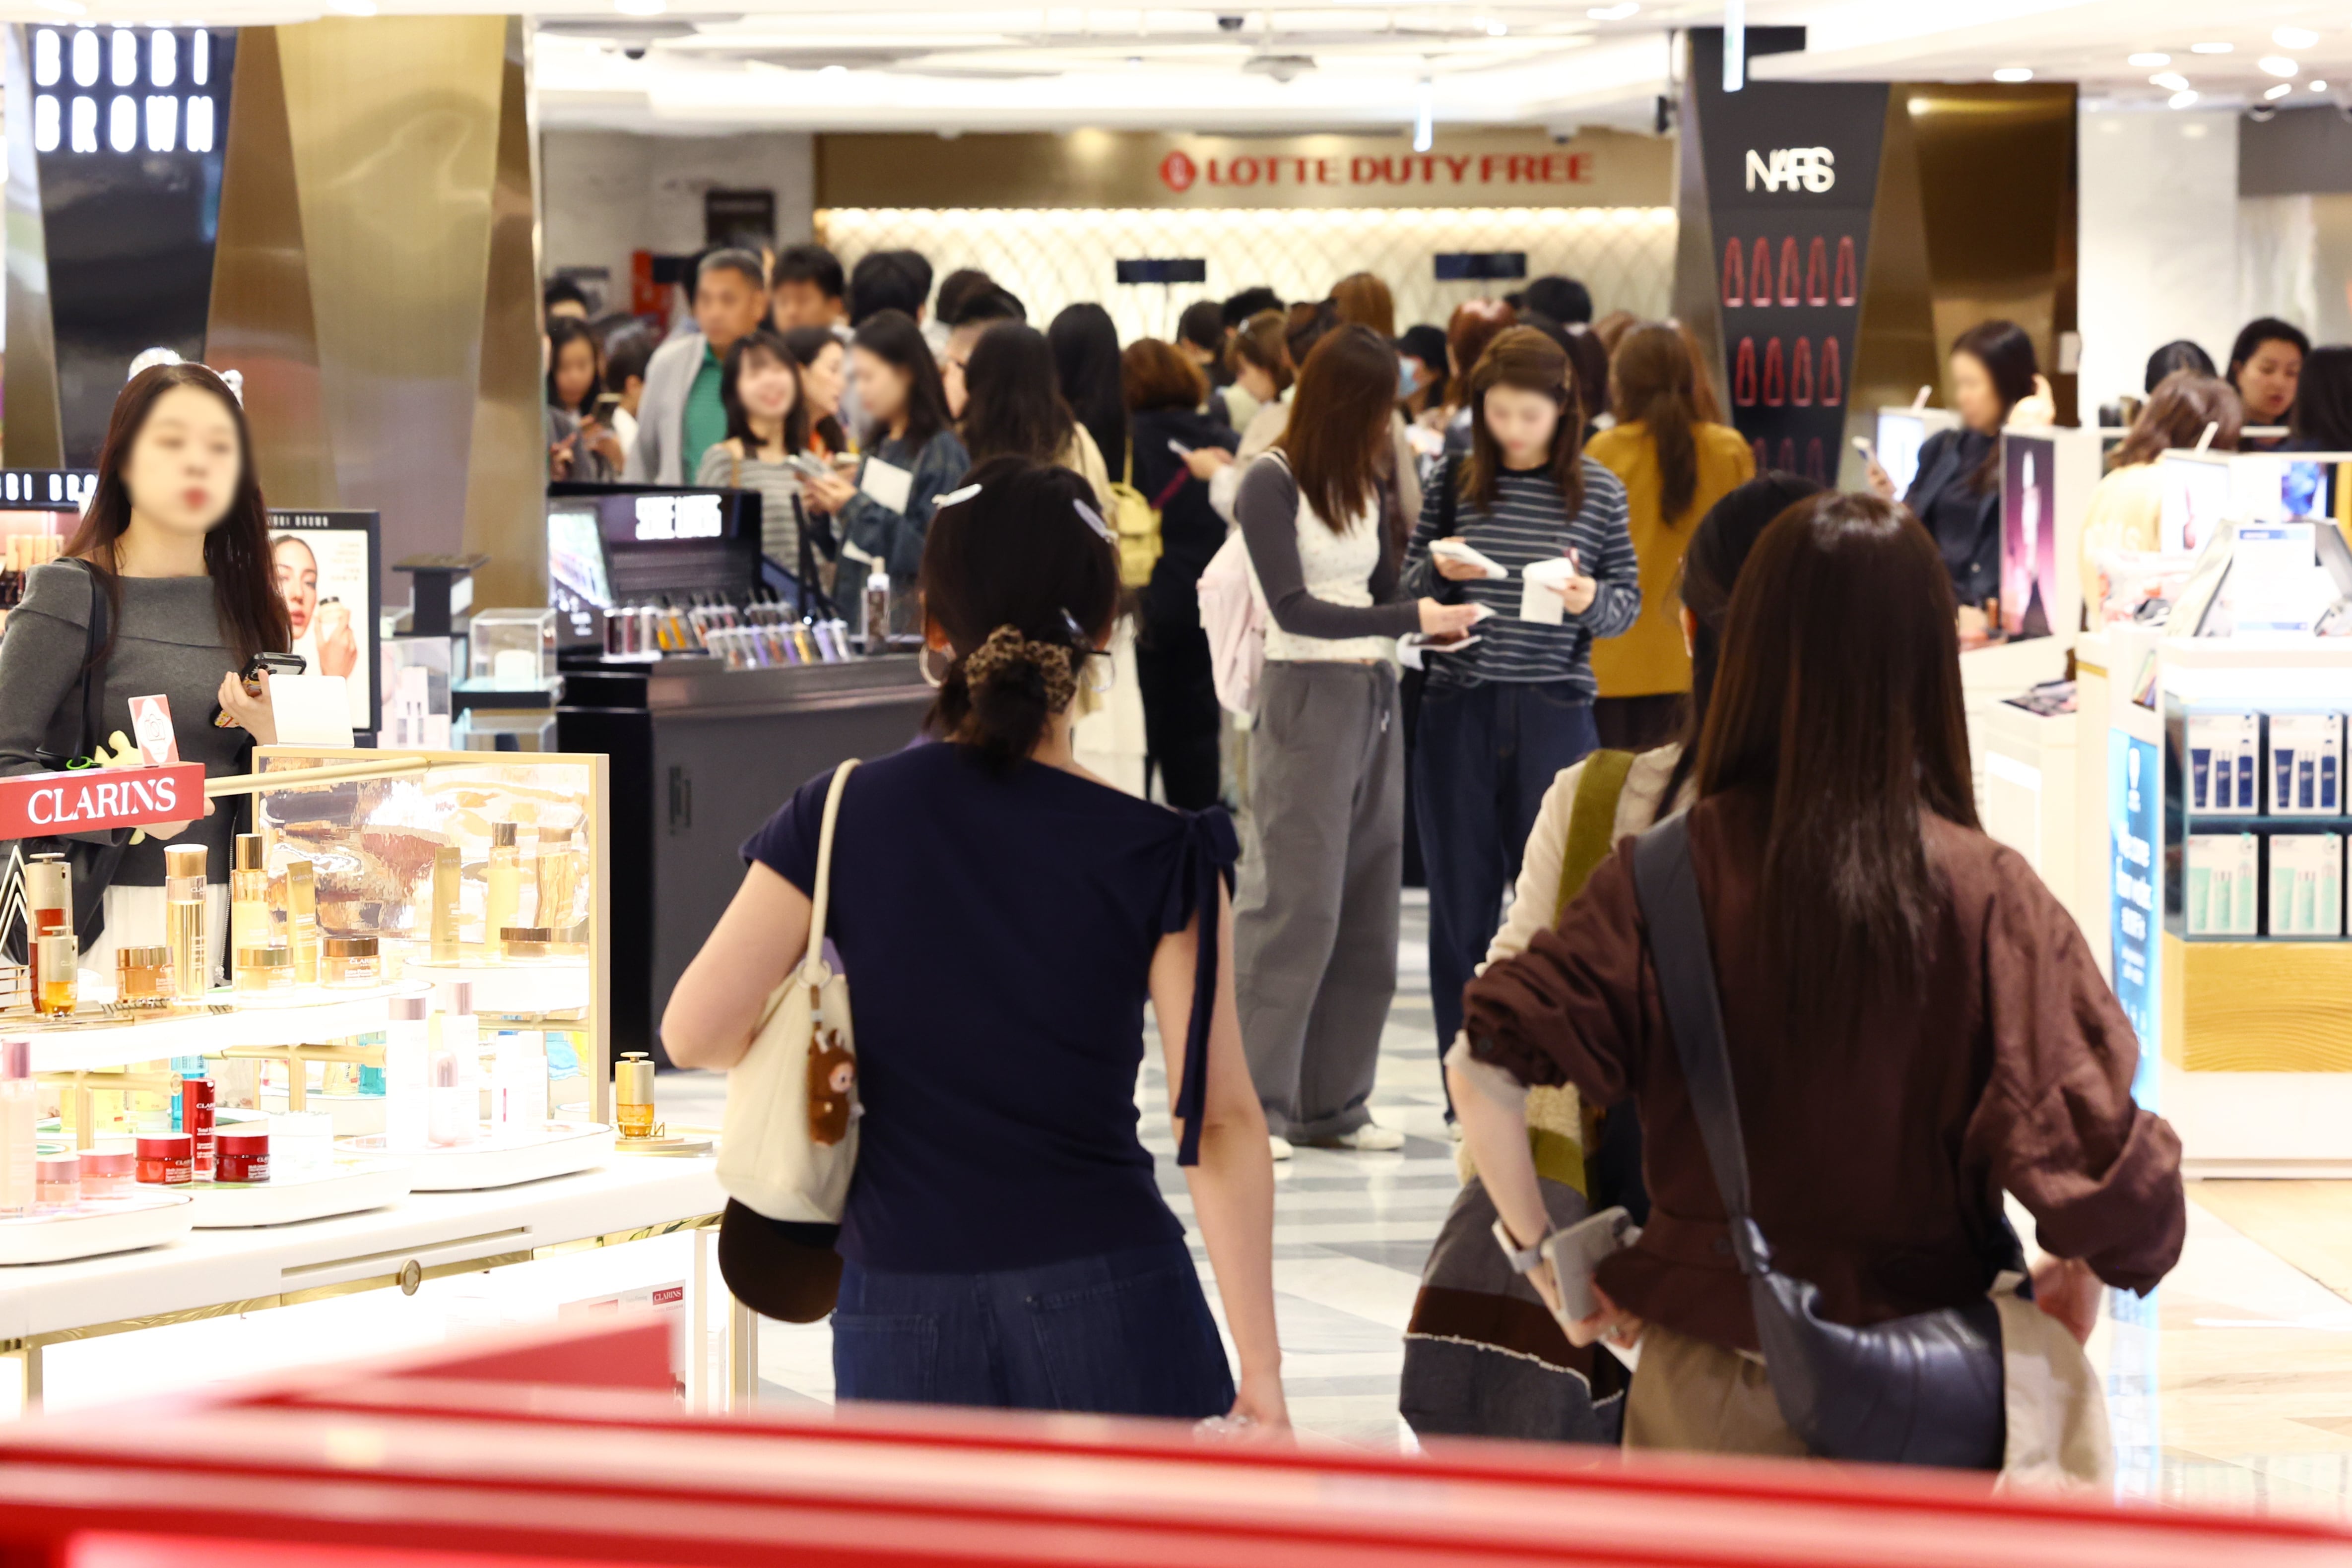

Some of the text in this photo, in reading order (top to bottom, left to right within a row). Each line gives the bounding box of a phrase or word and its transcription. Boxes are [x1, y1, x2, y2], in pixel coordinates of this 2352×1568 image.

[36, 29, 208, 87] BOBBI
[35, 94, 213, 153] BROWN
[1208, 153, 1593, 186] LOTTE DUTY FREE
[1746, 147, 1835, 192] NARS
[28, 777, 176, 824] CLARINS
[654, 1290, 682, 1302] CLARINS
